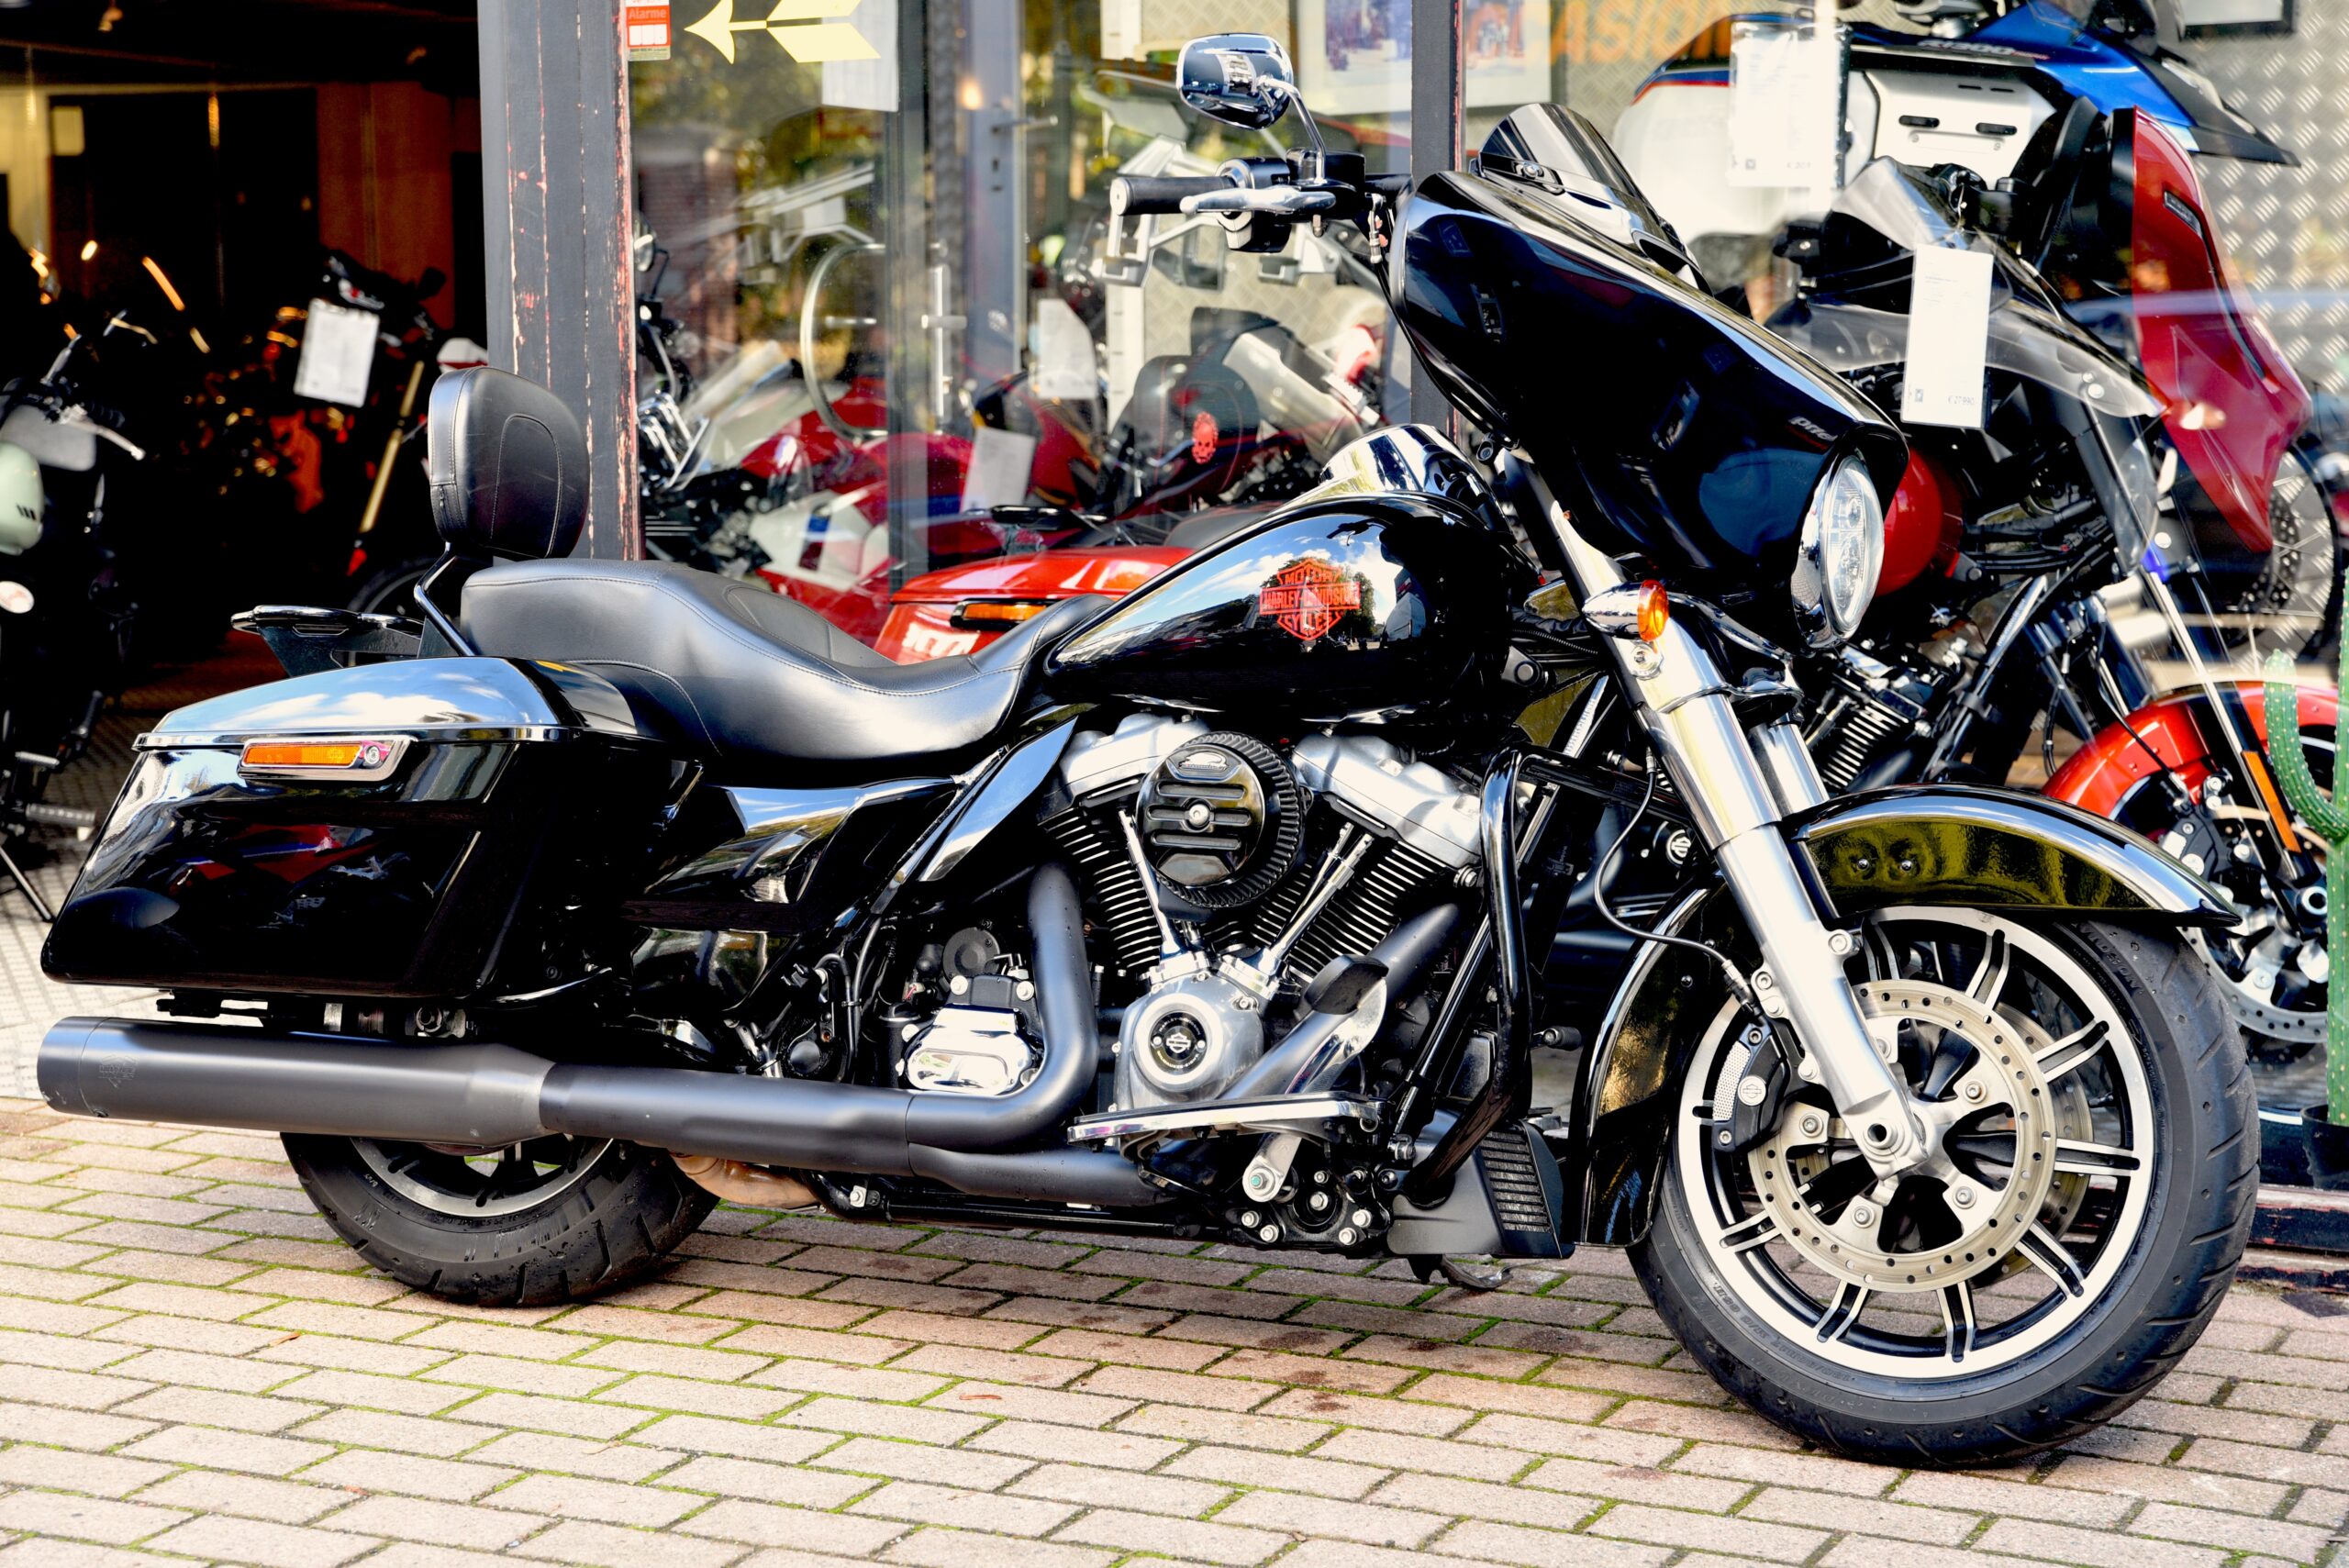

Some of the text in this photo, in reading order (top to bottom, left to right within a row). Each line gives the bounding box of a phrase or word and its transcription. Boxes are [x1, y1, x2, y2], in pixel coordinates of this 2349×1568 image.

[629, 7, 667, 19] Alarme
[1285, 566, 1335, 584] MOTOR
[1264, 586, 1358, 608] HARLEY-DAVIDSON
[1286, 610, 1333, 633] CYCLES
